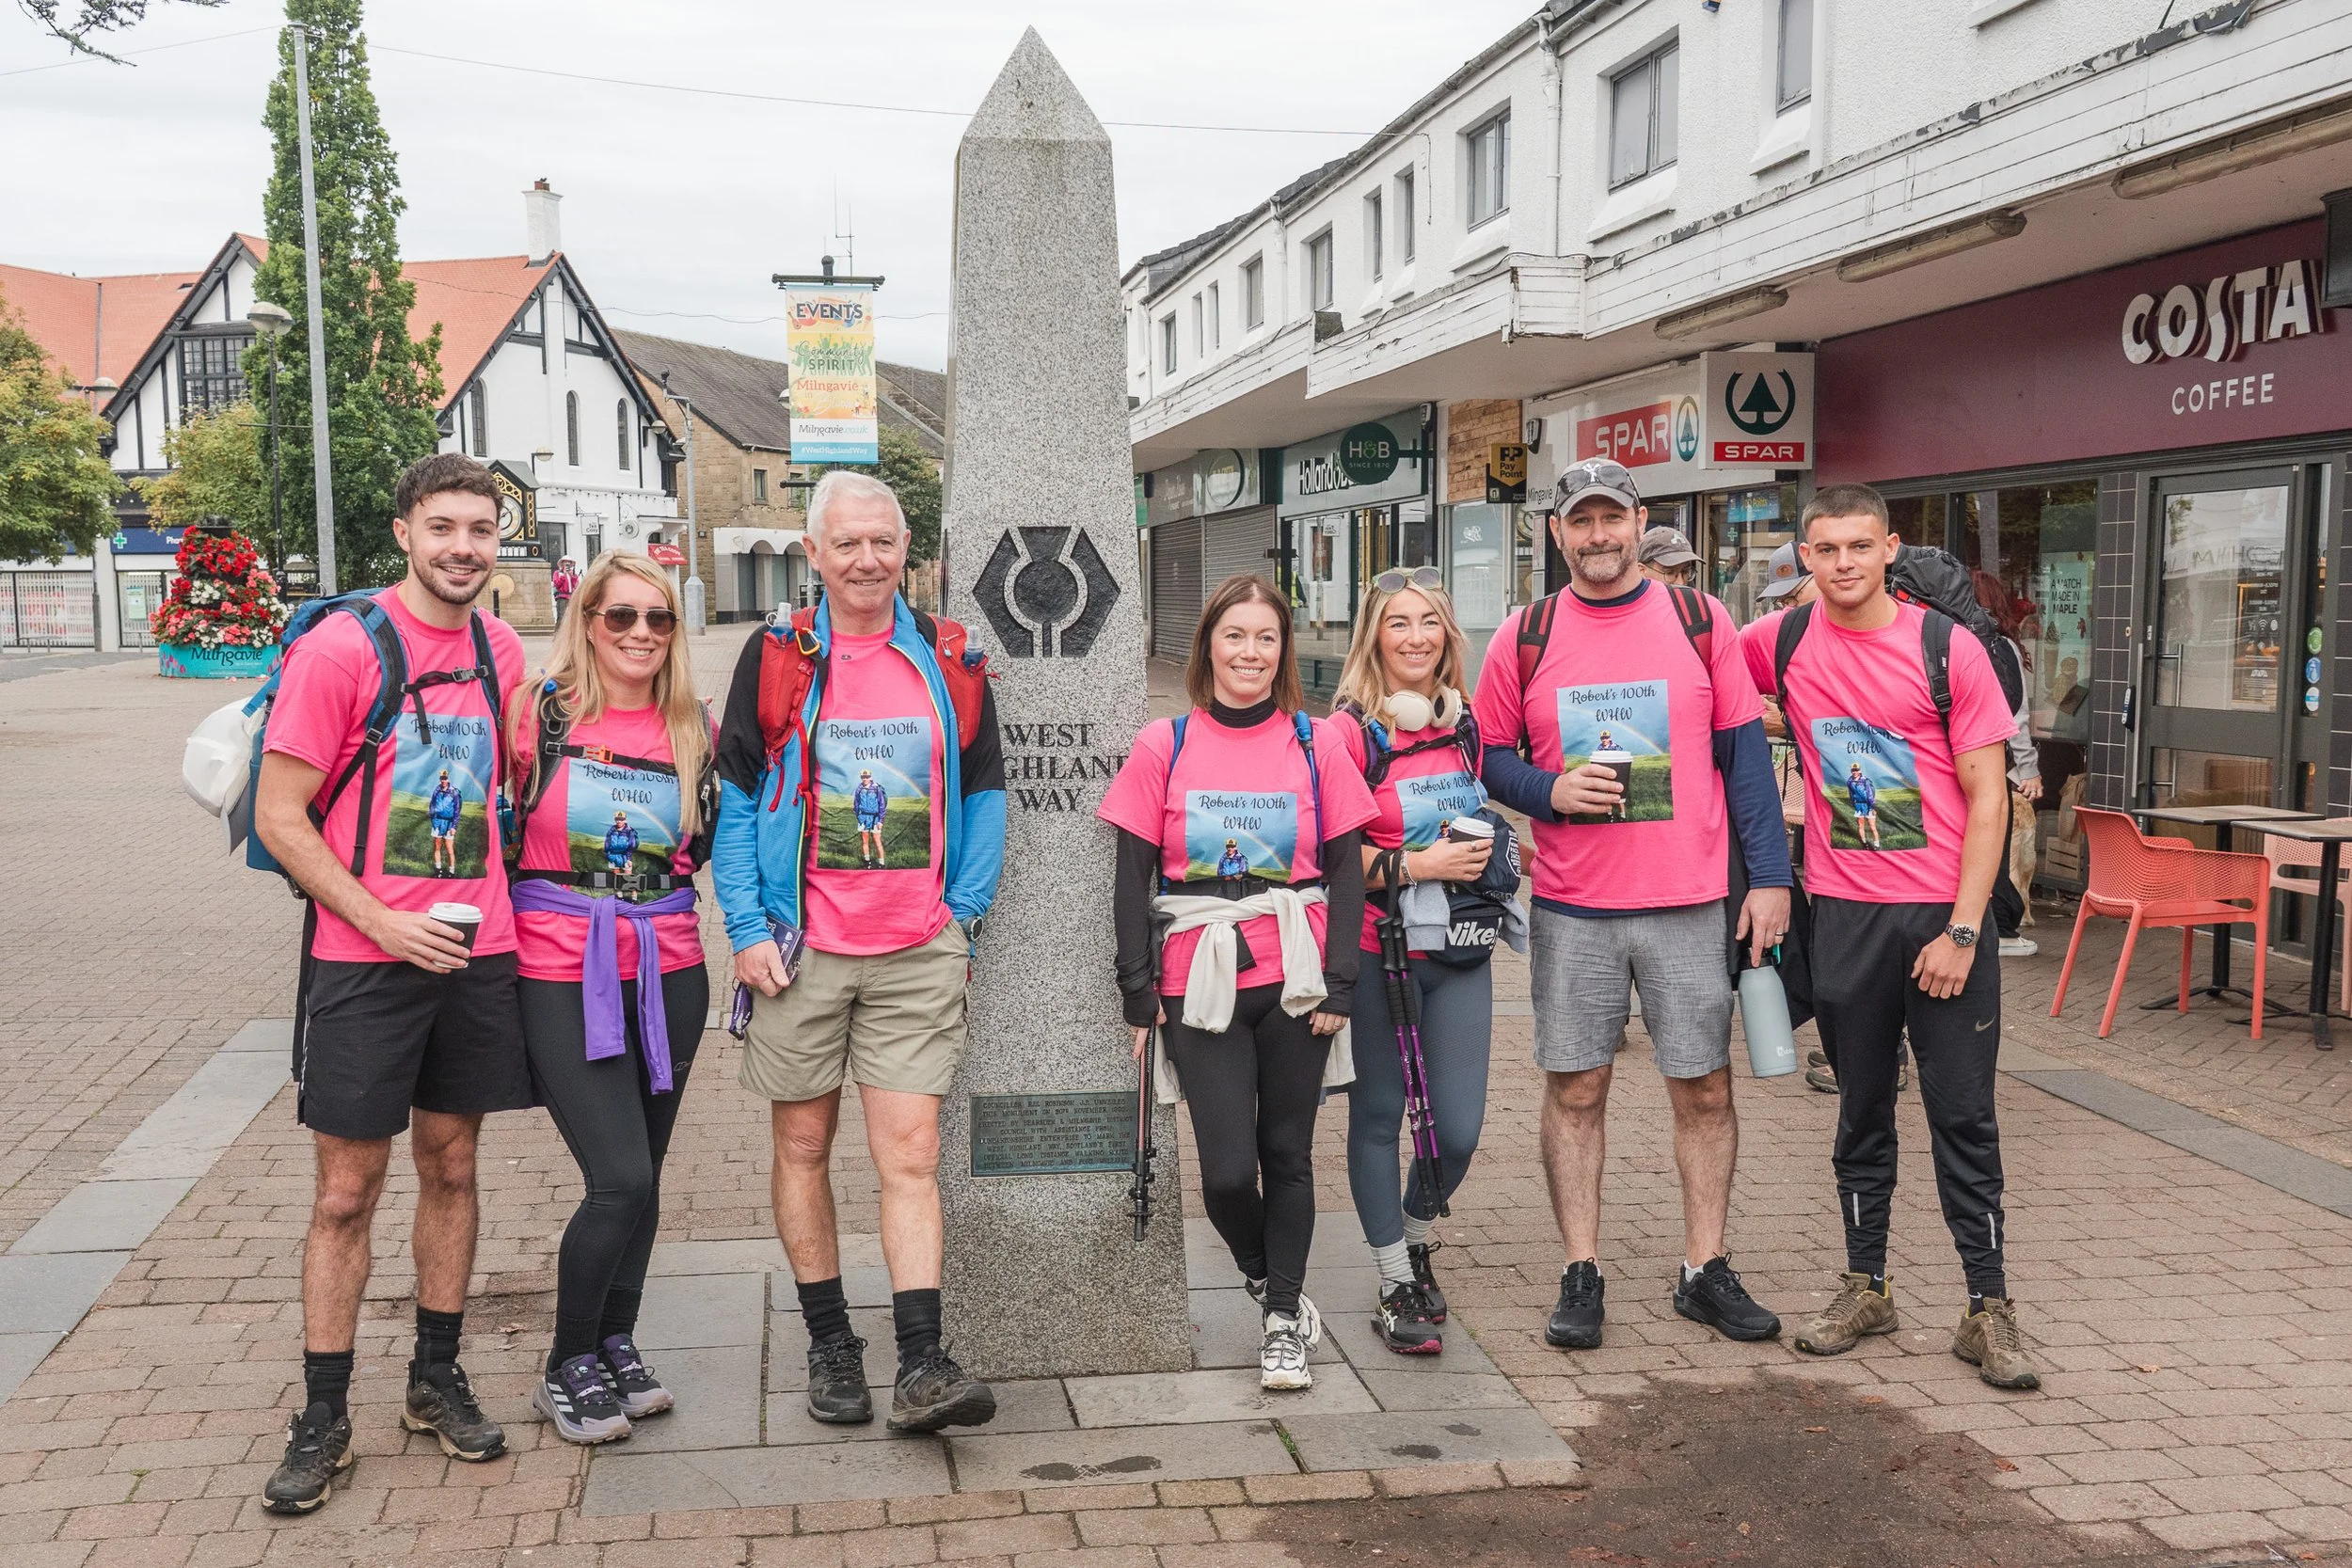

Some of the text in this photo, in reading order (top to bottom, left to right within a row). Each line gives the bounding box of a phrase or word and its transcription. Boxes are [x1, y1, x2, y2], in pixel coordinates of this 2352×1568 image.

[797, 302, 864, 320] EVENTS
[2122, 259, 2318, 365] COSTA
[798, 340, 865, 365] Community
[809, 358, 854, 371] SPIRIT
[797, 379, 859, 393] Milngavie
[2171, 372, 2275, 415] COFFEE
[1596, 413, 1670, 460] SPAR
[1349, 440, 1391, 459] H&B
[1724, 445, 1793, 459] SPAR
[1500, 463, 1515, 471] Pay
[1500, 469, 1524, 478] Point
[1528, 485, 1553, 506] Milngavie
[2051, 578, 2057, 589] A
[2052, 592, 2080, 601] MADE IN
[2053, 604, 2078, 614] MAPLE
[191, 647, 263, 666] Milngavie
[1569, 685, 1657, 704] Robert's 100th
[1596, 706, 1632, 721] WHW
[827, 721, 920, 739] Robert's 100th
[1003, 723, 1094, 748] WEST
[854, 744, 894, 760] WHW
[583, 763, 637, 781] Robert's
[1003, 755, 1129, 780] GHLAN
[1409, 776, 1475, 796] Robert's 100
[612, 787, 653, 804] WHW
[1015, 788, 1082, 812] WAY
[1199, 795, 1287, 809] Robert's 100th
[1437, 796, 1467, 811] WHW
[1223, 816, 1262, 830] WHW
[1446, 921, 1496, 946] Nike
